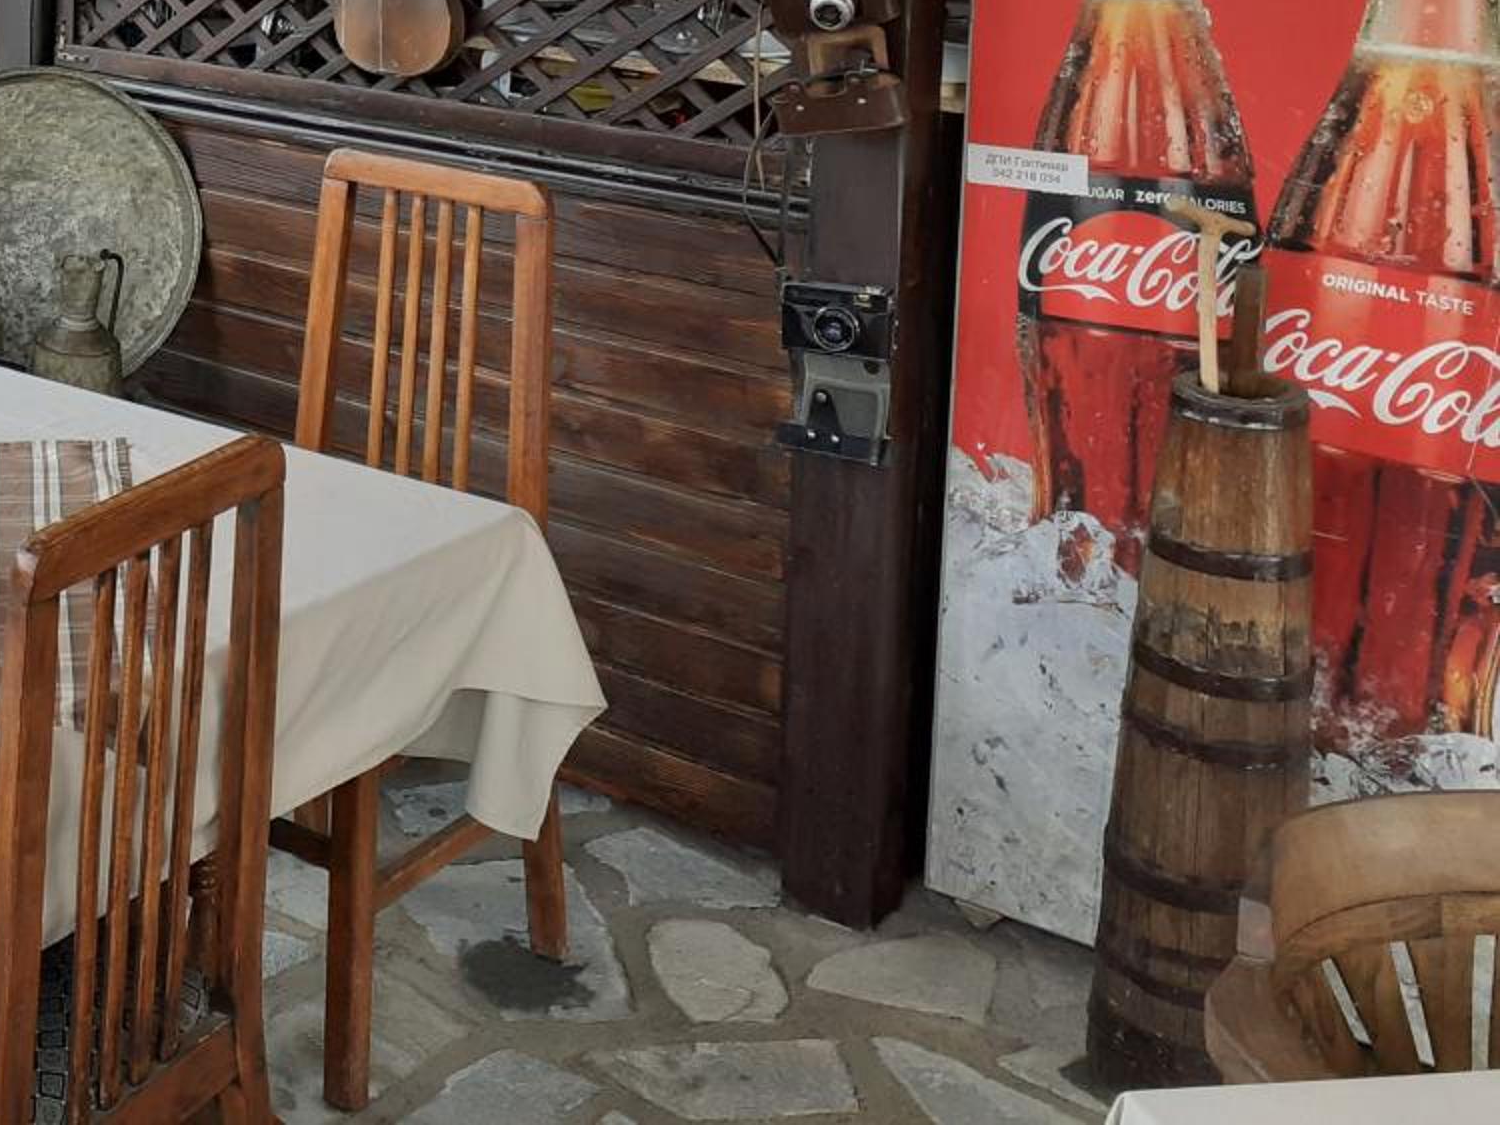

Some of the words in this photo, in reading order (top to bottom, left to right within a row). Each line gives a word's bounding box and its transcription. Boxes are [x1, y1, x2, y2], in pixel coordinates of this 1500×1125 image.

[1088, 186, 1125, 202] UGAR
[1322, 273, 1411, 303] ORIGINAL
[1415, 289, 1476, 316] TASTE
